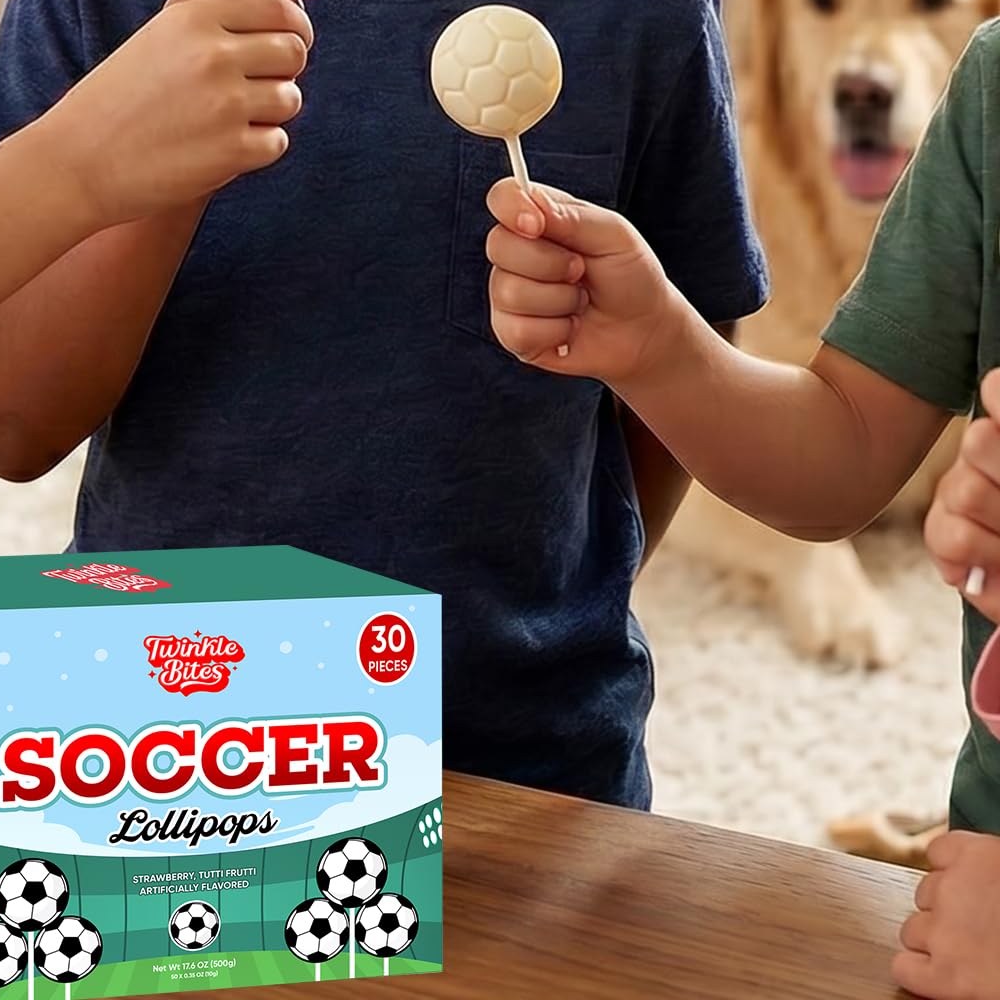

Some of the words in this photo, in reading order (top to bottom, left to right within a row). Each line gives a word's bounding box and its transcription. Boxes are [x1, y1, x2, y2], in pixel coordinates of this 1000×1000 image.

[144, 634, 240, 661] Twinkle
[370, 624, 406, 653] 30
[160, 658, 226, 689] Bites
[368, 659, 408, 673] PIECES
[2, 720, 379, 802] SOCCER
[108, 809, 279, 847] Lollipops
[132, 871, 196, 884] STRAWBERRY,
[199, 869, 224, 879] TUTTI
[225, 867, 256, 877] FRUTTI
[139, 884, 199, 896] ARTIFICIALLY
[201, 880, 250, 891] FLAVORED
[152, 965, 167, 973] Net
[168, 963, 181, 972] Wt
[182, 962, 196, 970] 17.6
[197, 961, 209, 969] OZ
[210, 958, 237, 969] (500g)
